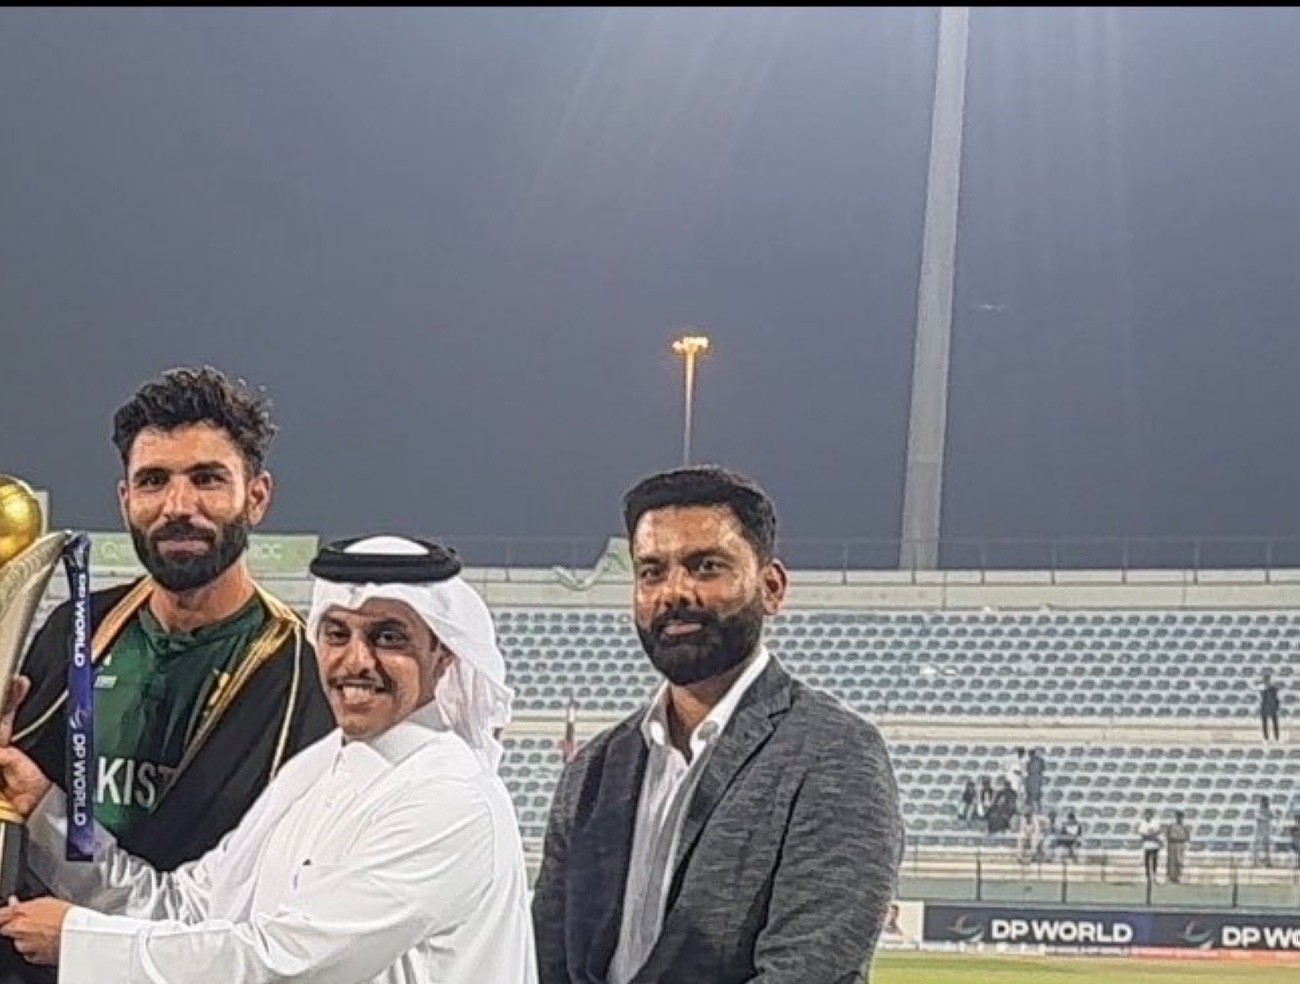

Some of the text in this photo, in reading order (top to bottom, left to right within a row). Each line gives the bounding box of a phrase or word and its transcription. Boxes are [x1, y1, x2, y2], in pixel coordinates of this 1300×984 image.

[74, 600, 86, 667] WORLD
[72, 733, 87, 826] DP WORLD
[991, 919, 1133, 944] DP WORLD
[1222, 925, 1260, 948] DP
